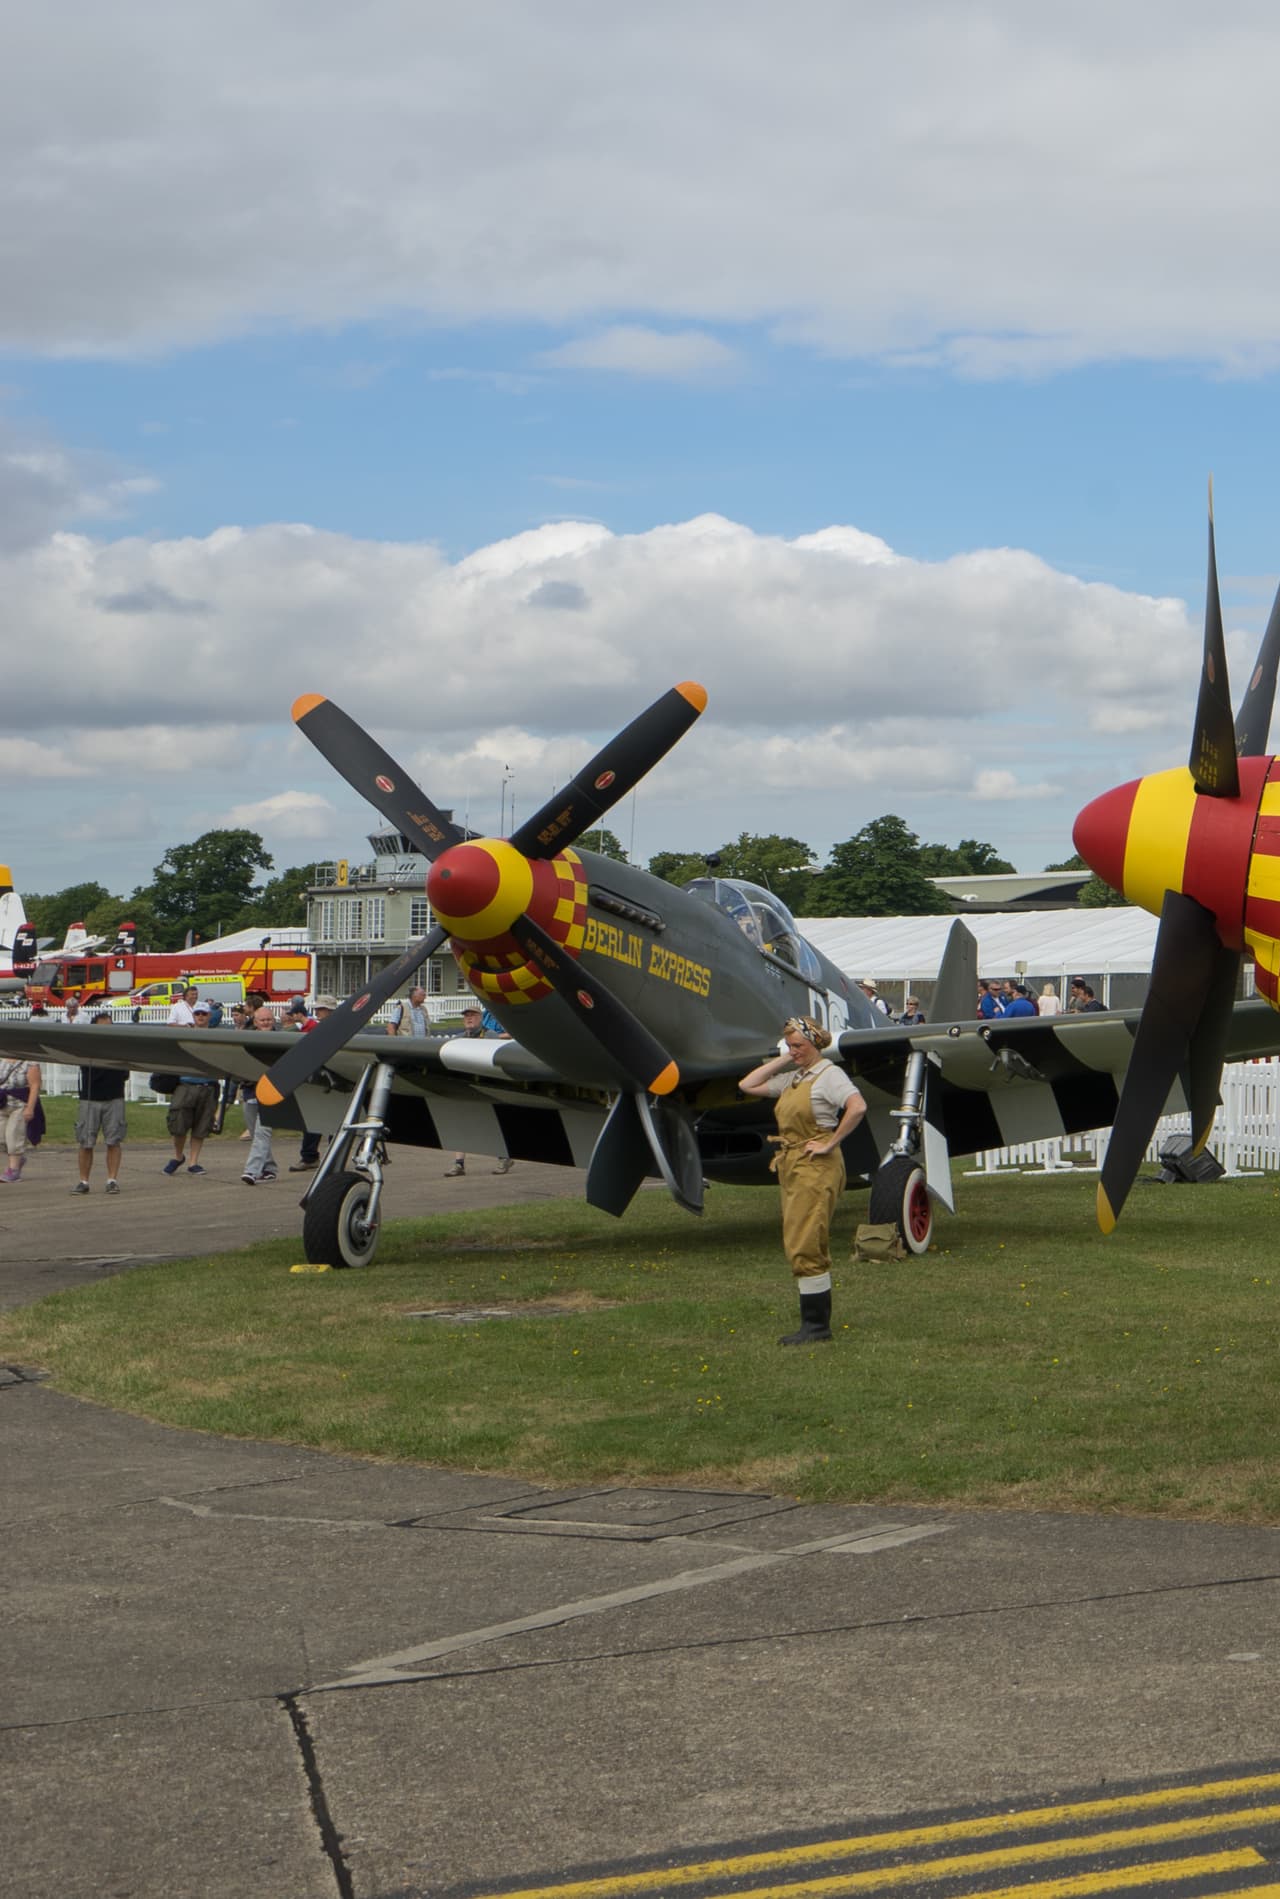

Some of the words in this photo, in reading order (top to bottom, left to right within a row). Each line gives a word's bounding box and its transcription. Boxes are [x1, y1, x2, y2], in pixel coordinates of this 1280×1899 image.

[116, 959, 124, 968] 4
[583, 918, 644, 969] BERLIN
[647, 944, 712, 997] EXPRESS
